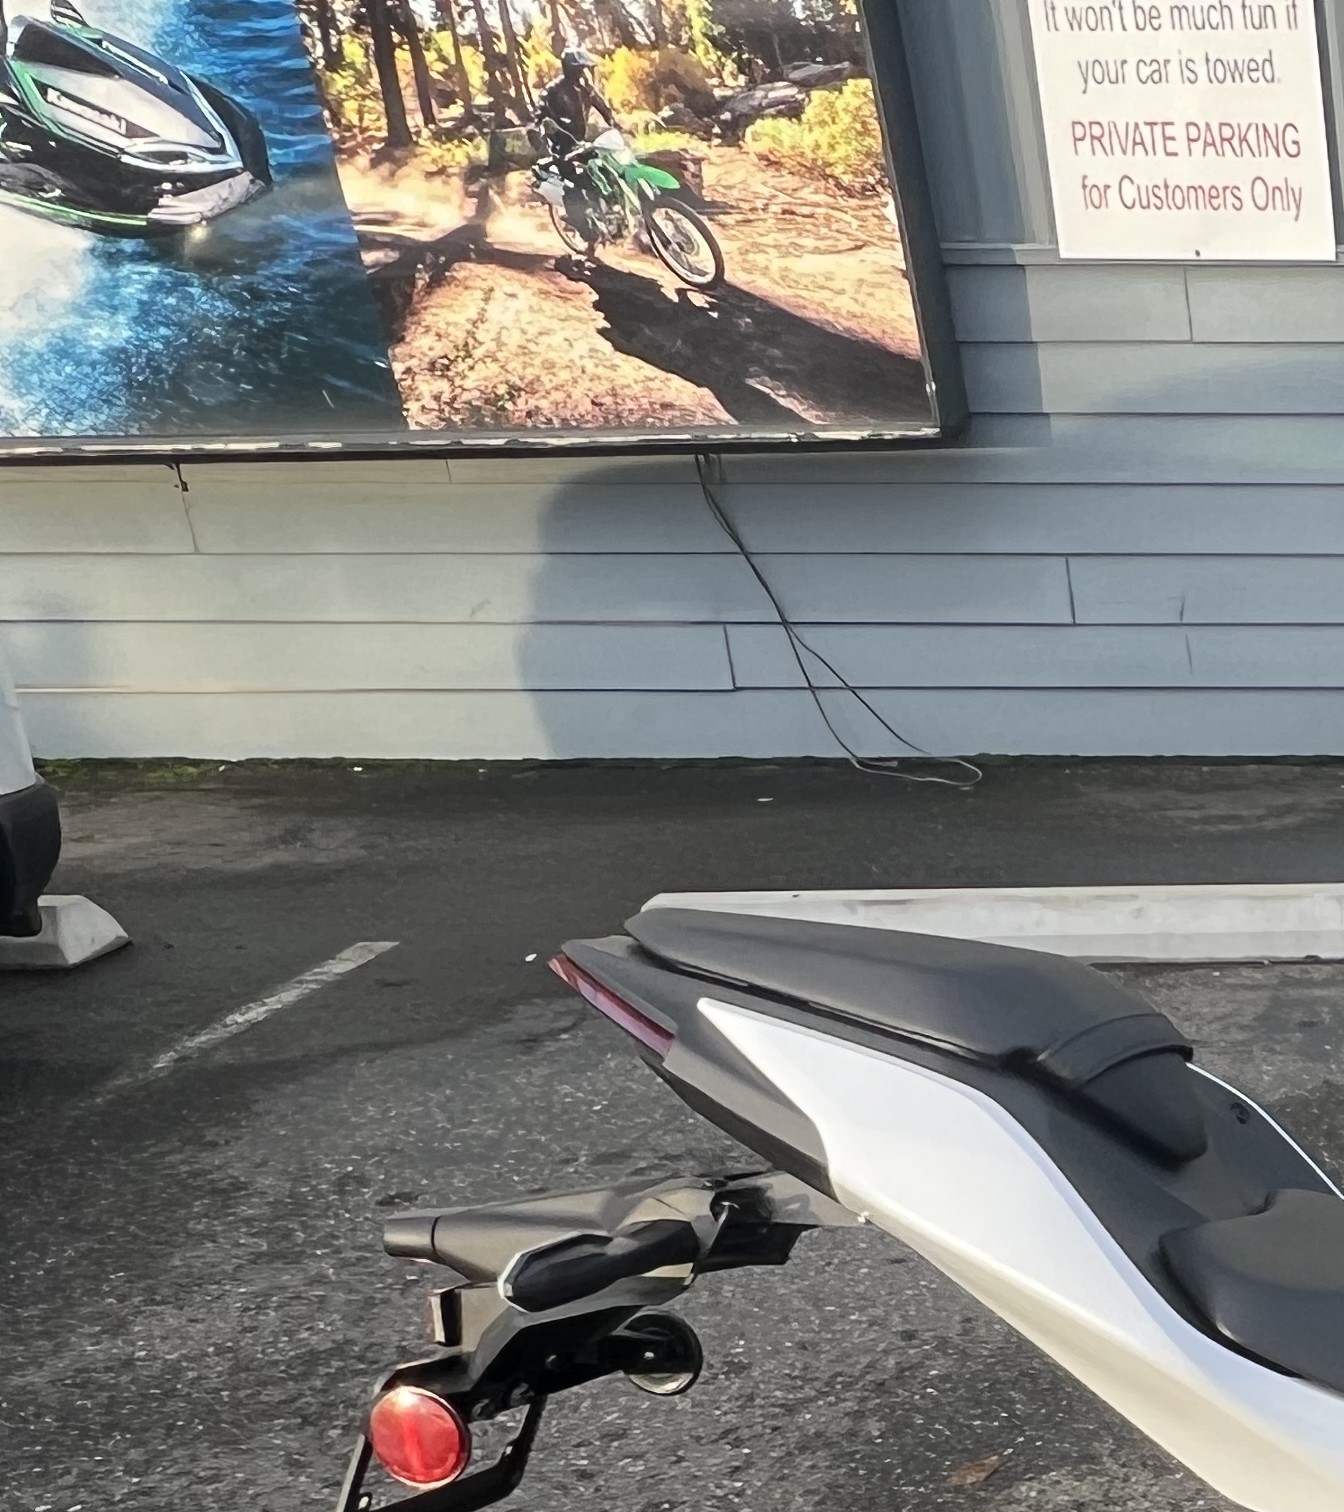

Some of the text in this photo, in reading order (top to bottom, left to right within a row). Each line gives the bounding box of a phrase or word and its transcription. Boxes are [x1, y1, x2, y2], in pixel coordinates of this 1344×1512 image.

[1043, 0, 1300, 32] It won't be much fun if
[1077, 49, 1282, 94] your car is towed.
[1071, 120, 1302, 159] PRIVATE PARKING
[1081, 174, 1303, 223] for Customers Only
